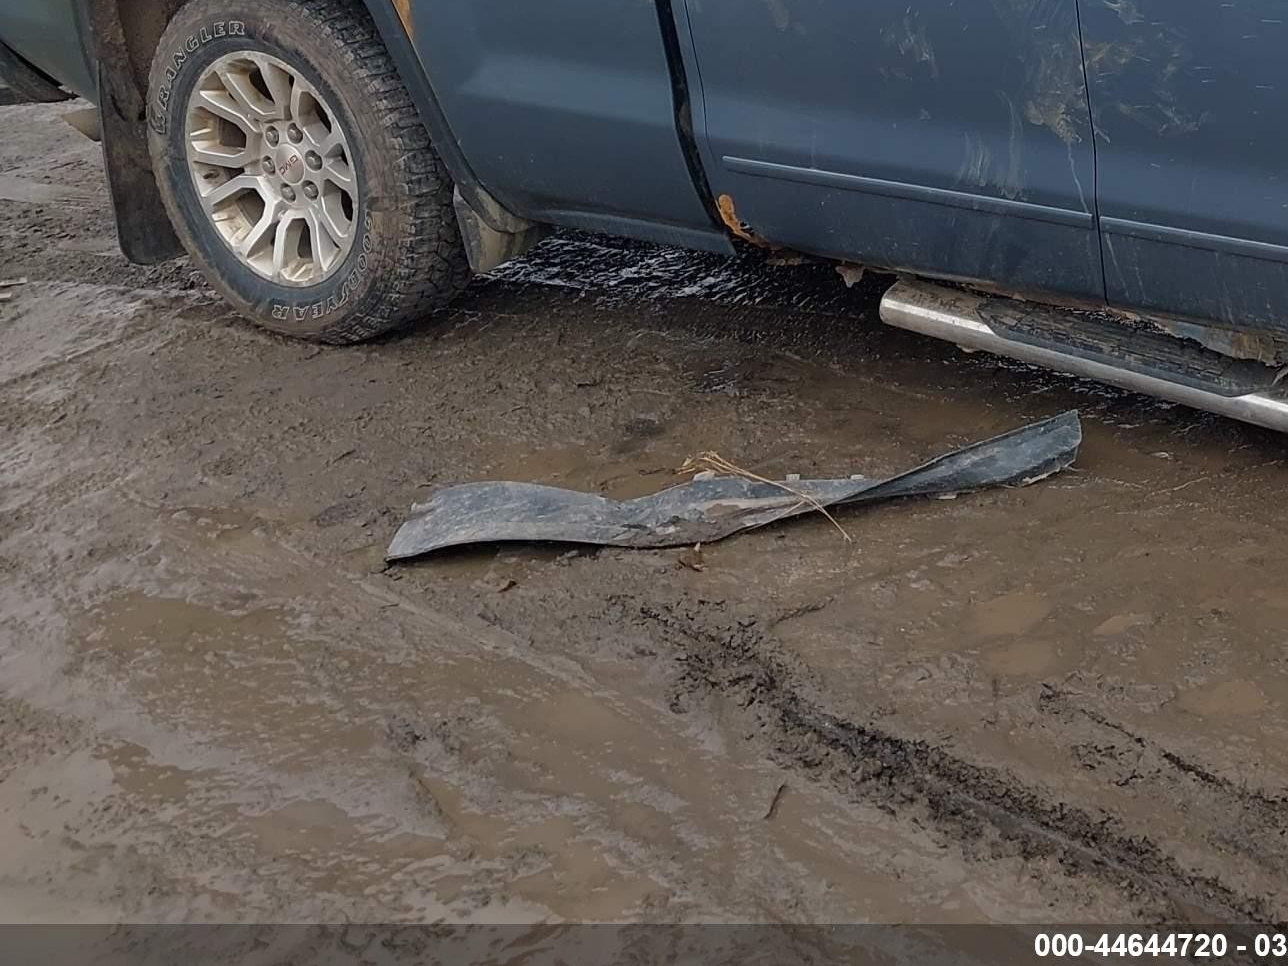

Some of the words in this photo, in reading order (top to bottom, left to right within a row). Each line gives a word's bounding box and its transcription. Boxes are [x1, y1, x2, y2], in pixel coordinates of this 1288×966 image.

[146, 20, 246, 134] WRANGLER
[279, 153, 299, 176] GMC
[271, 210, 373, 321] GOODYEAR
